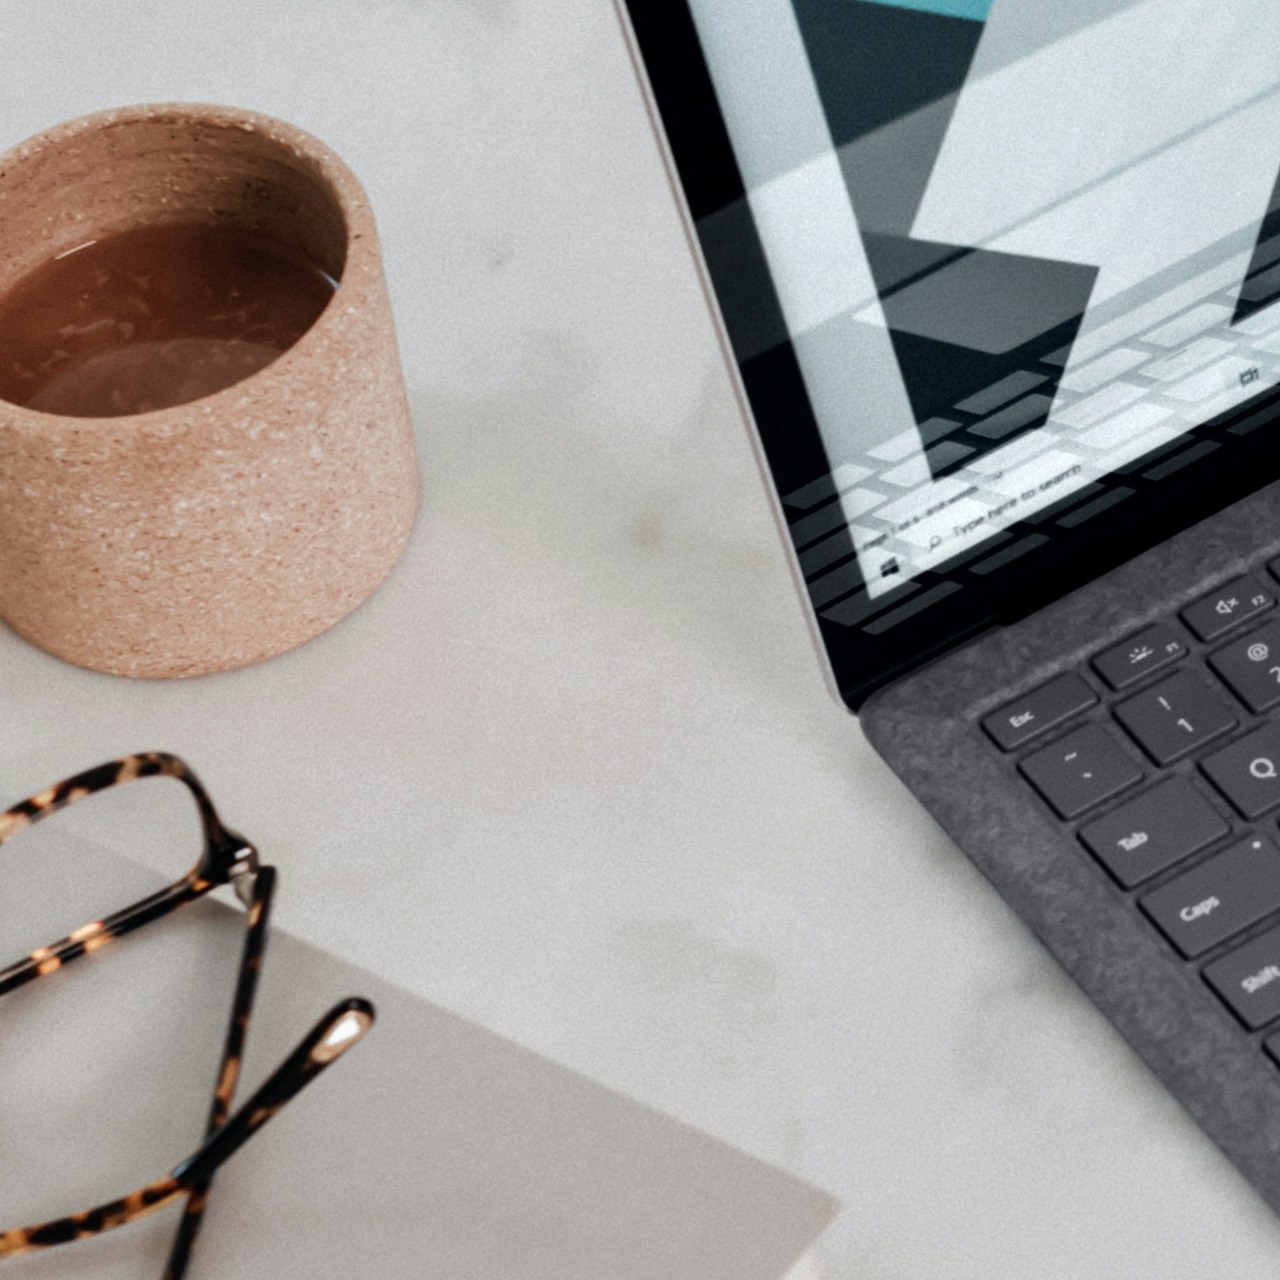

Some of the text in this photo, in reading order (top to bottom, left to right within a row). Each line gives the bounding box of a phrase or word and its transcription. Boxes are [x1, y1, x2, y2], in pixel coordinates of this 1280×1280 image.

[1008, 711, 1034, 728] Esc
[1177, 717, 1194, 732] 1
[1249, 757, 1278, 779] Q
[1117, 832, 1149, 851] Tab
[1179, 896, 1220, 922] Caps
